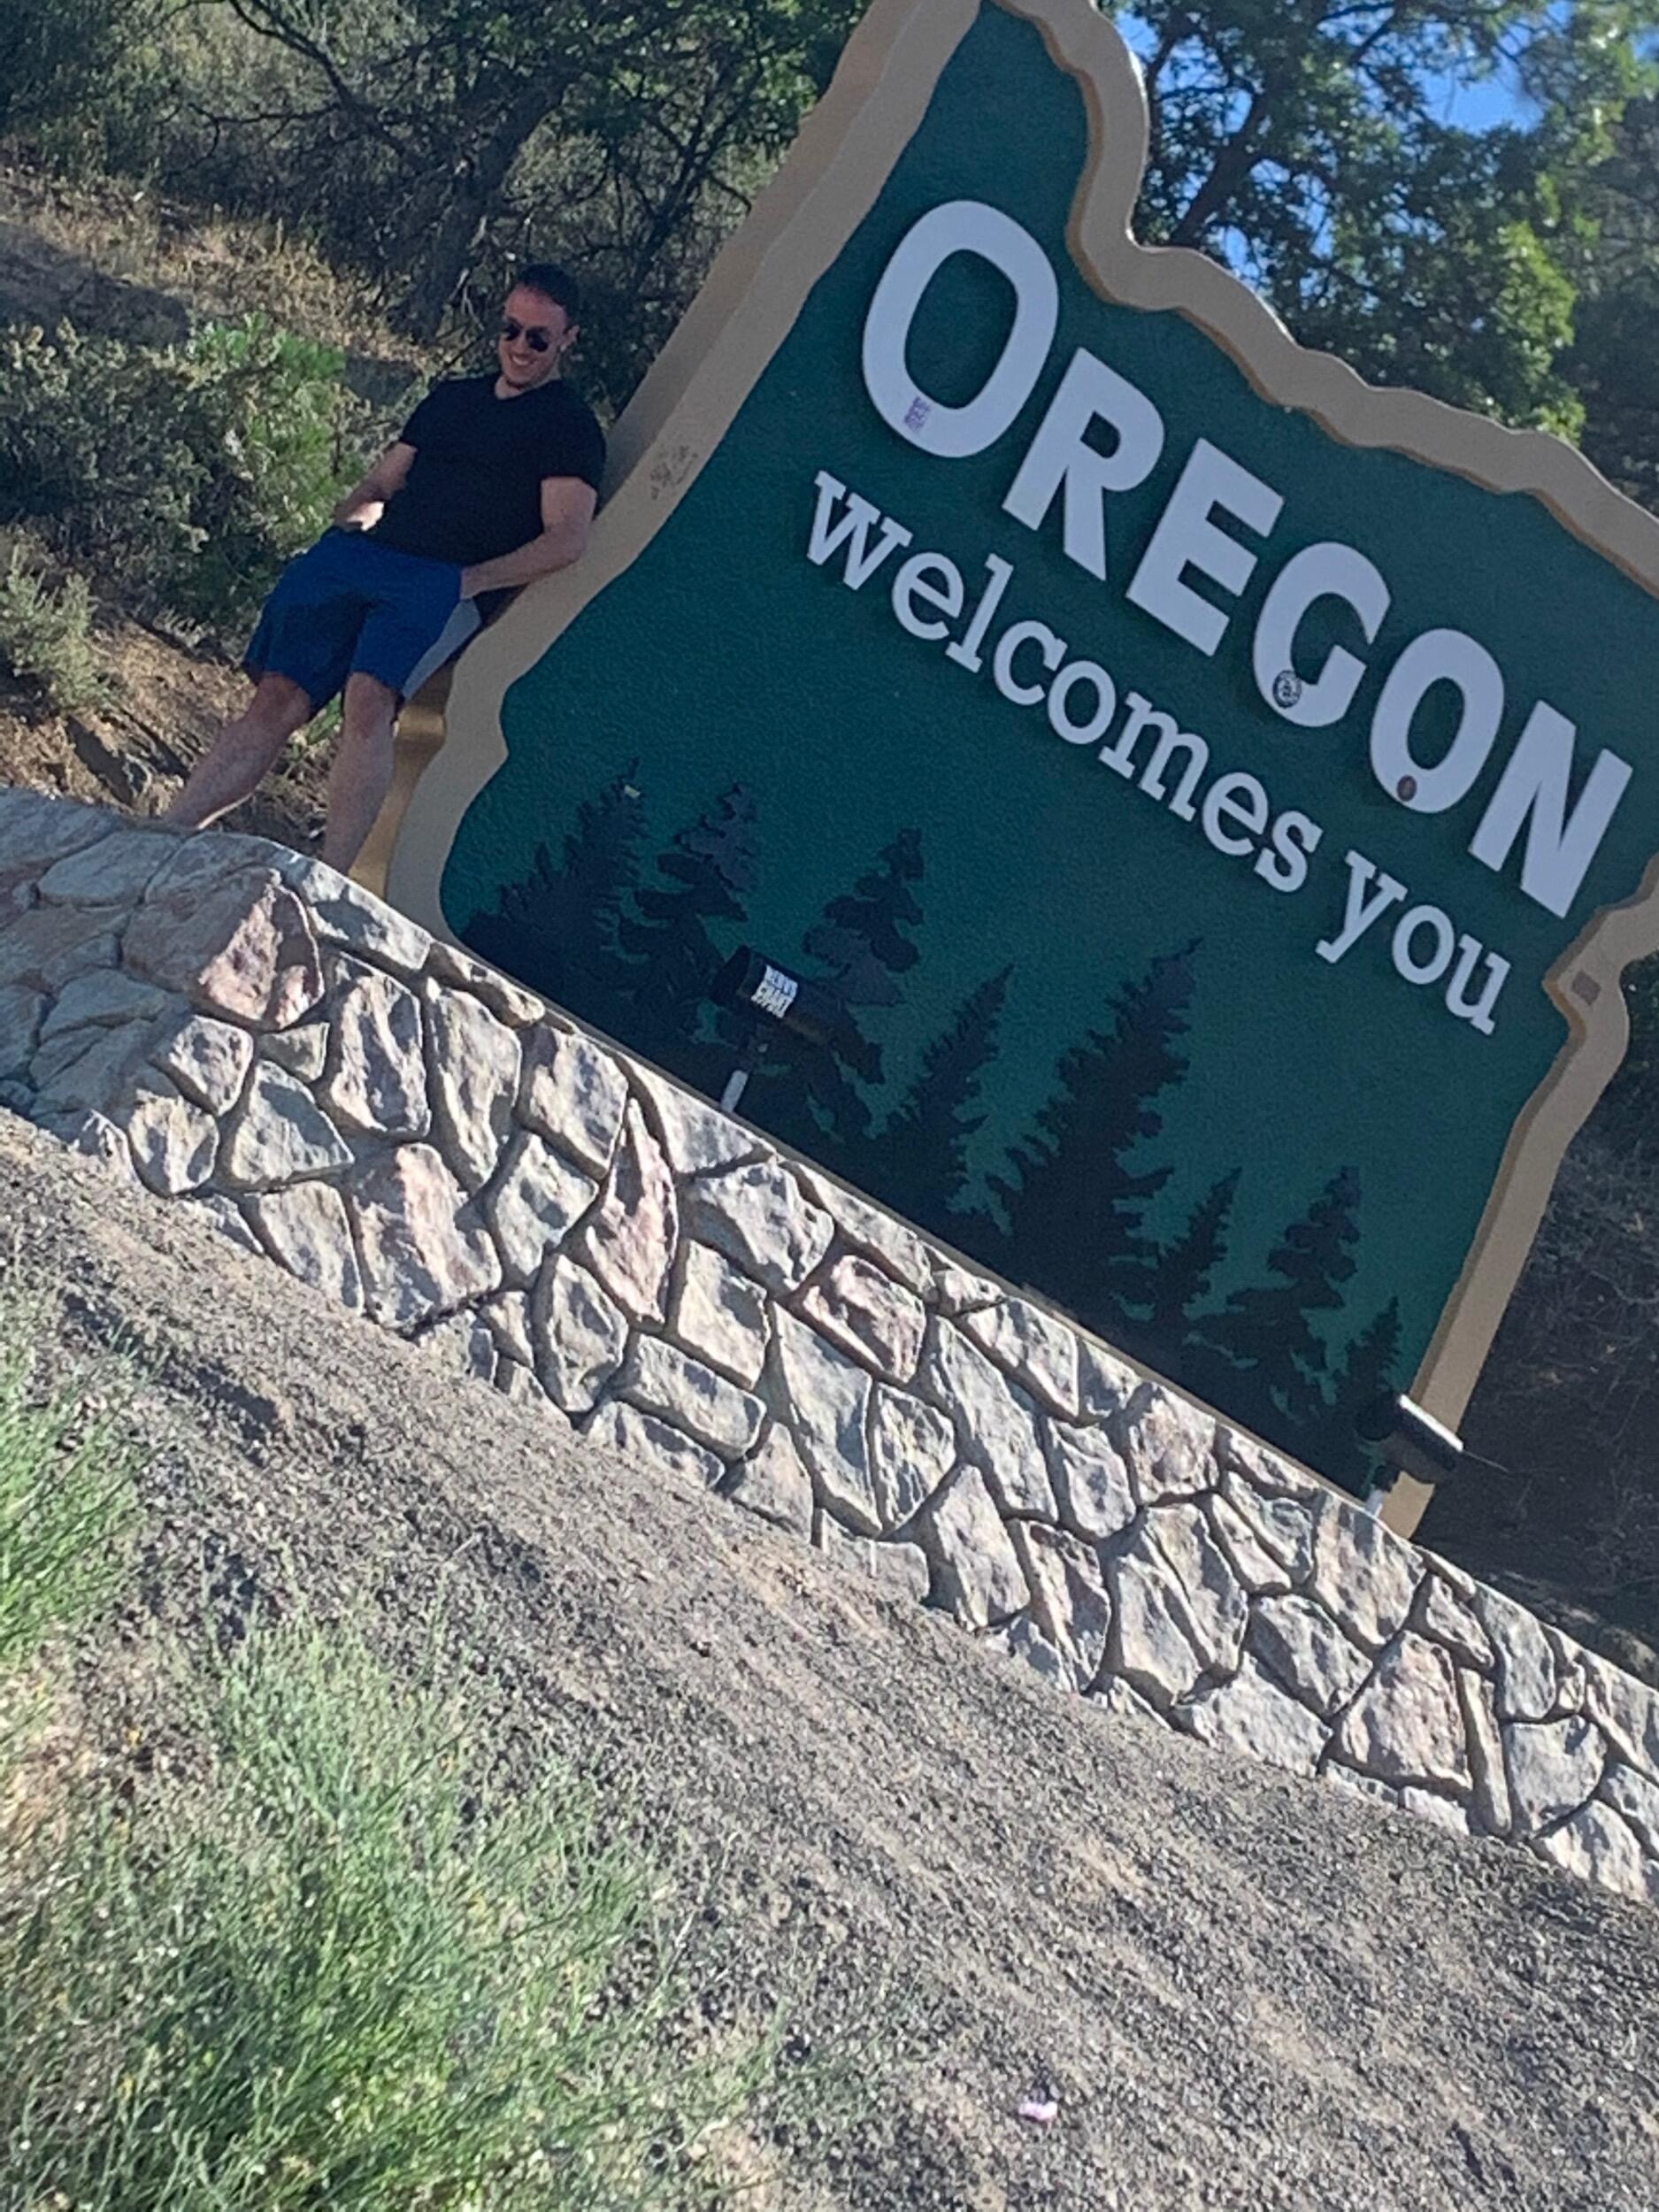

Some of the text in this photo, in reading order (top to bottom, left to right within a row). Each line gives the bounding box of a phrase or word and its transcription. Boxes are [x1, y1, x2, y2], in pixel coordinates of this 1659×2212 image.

[806, 470, 1511, 1035] welcomes you
[863, 200, 1633, 919] OREGON
